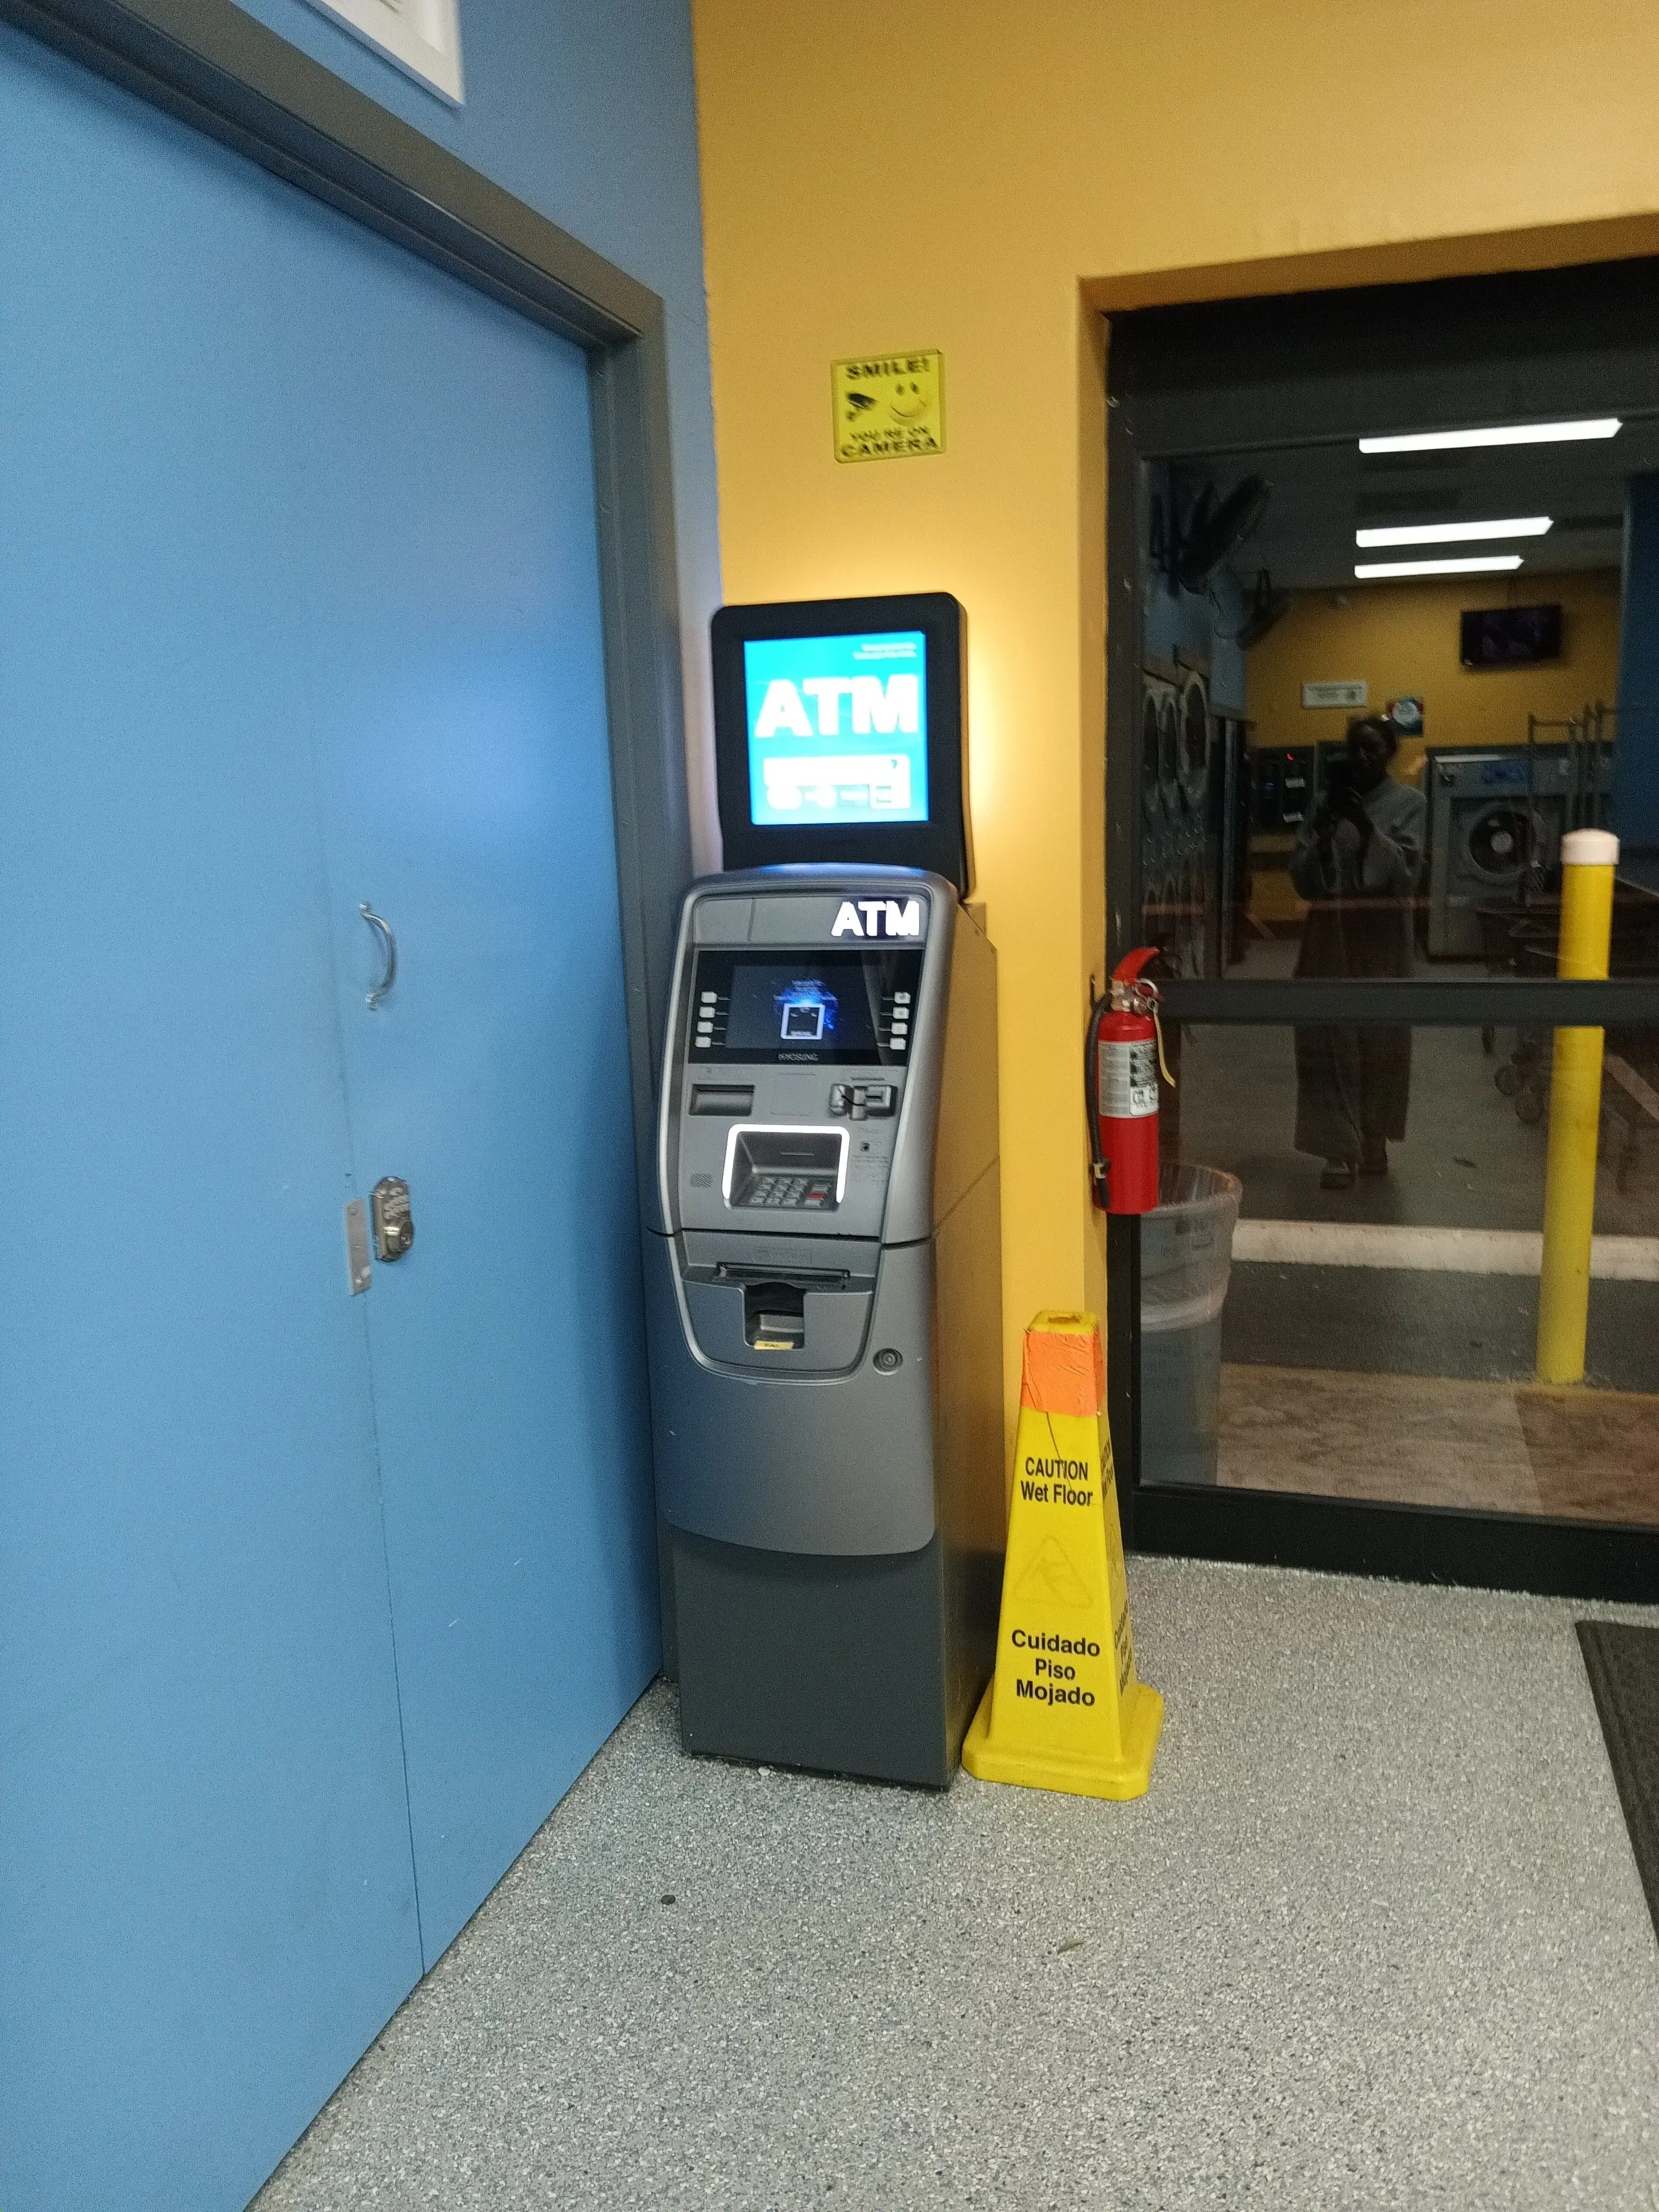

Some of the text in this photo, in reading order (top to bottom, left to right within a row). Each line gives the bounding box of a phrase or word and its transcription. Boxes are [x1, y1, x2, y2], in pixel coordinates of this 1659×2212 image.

[841, 436, 939, 457] CAMERA
[754, 674, 918, 738] ATM
[831, 900, 919, 936] ATM
[1025, 1456, 1088, 1481] CAUTION
[1020, 1480, 1093, 1507] Wet Floor
[1011, 1629, 1101, 1657] Cuidado
[1035, 1658, 1076, 1681] Piso
[1016, 1679, 1095, 1707] Mojado
